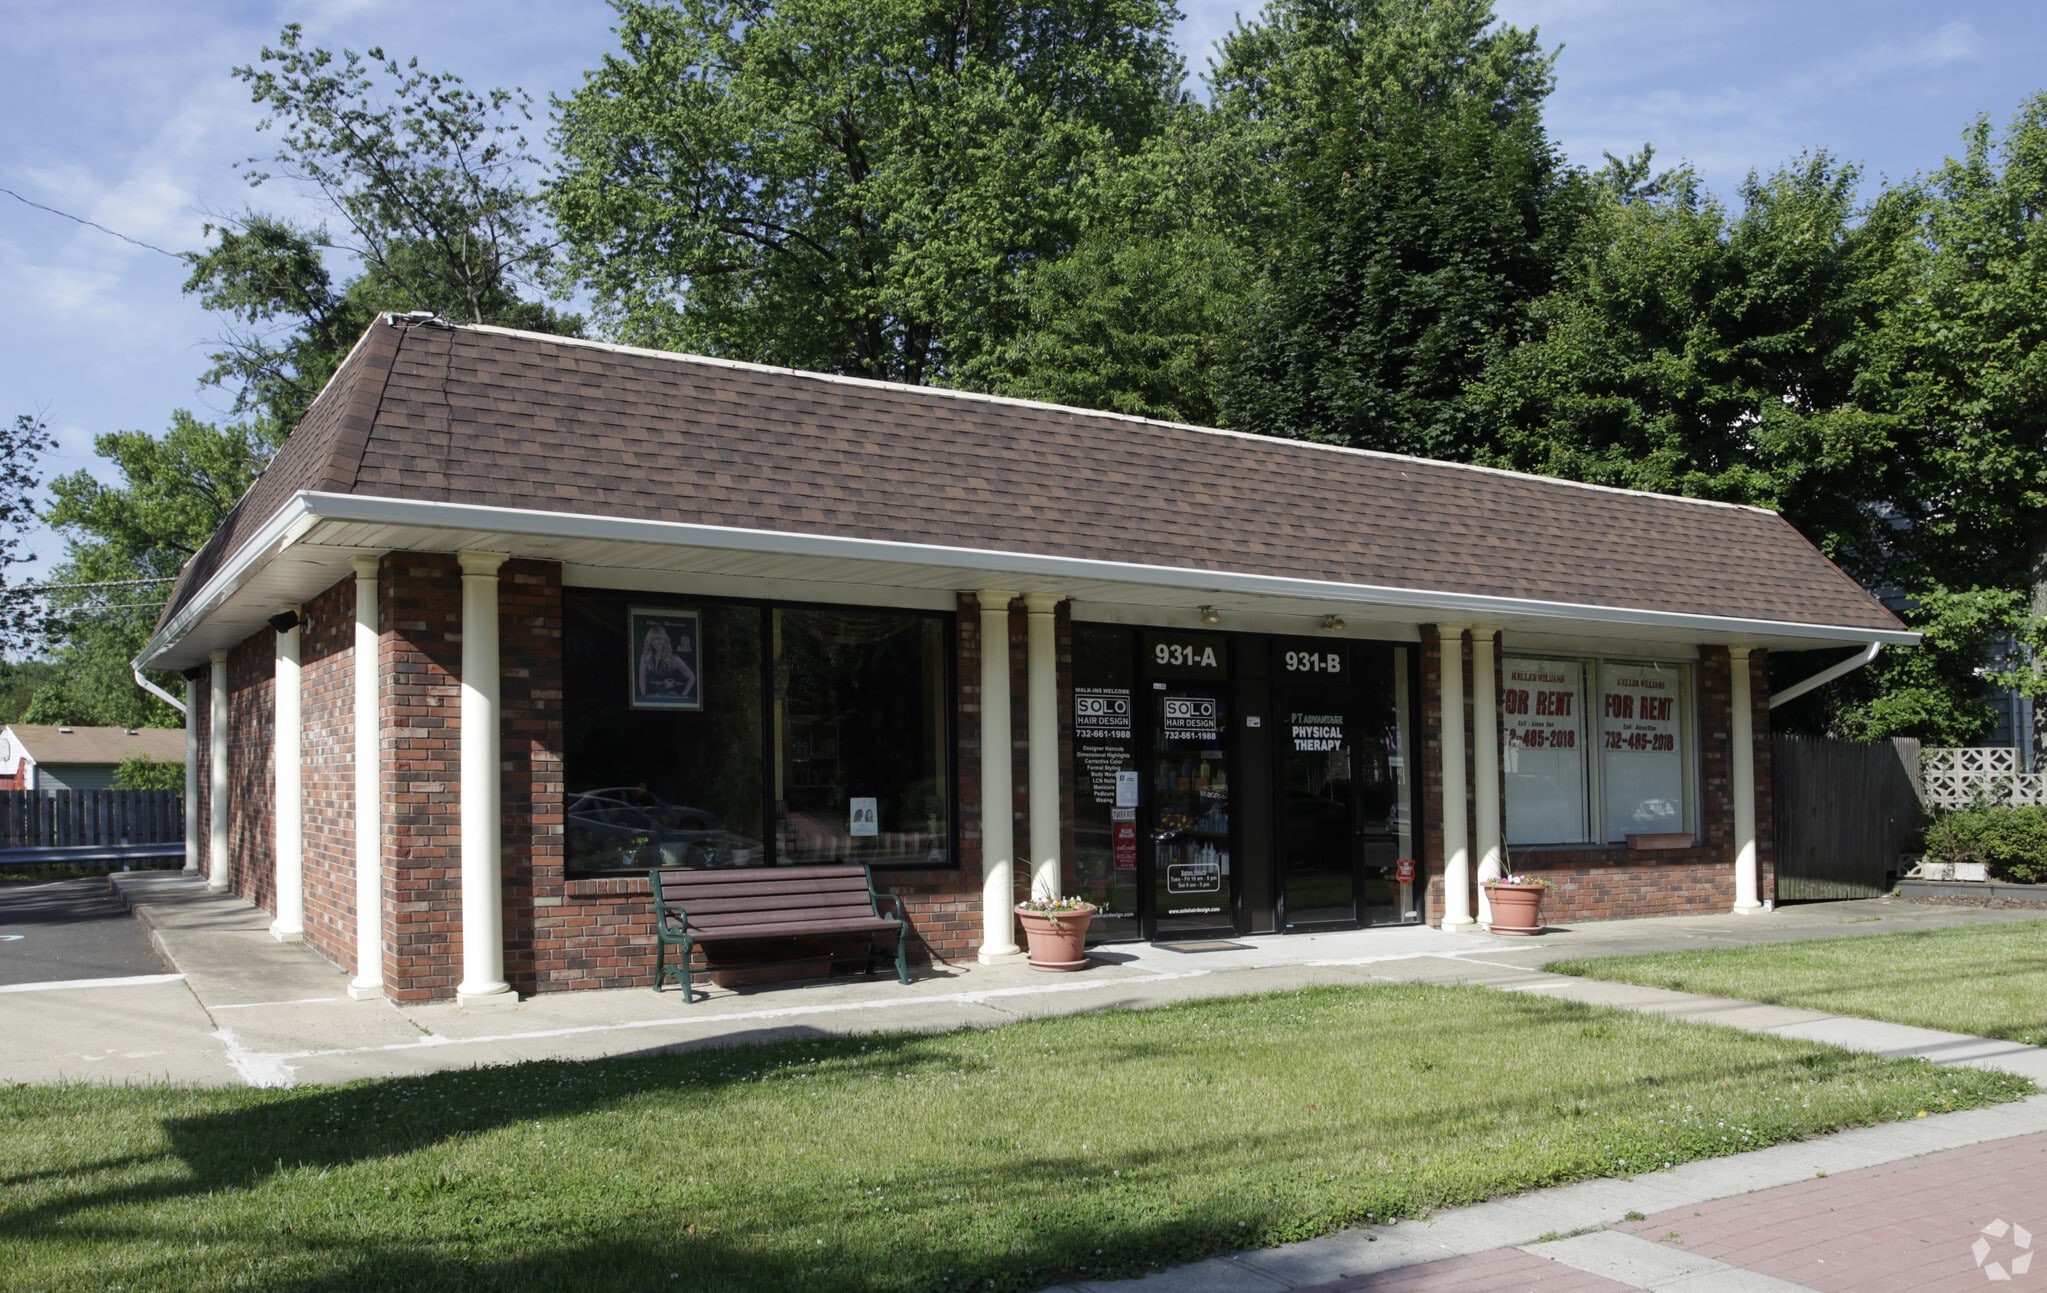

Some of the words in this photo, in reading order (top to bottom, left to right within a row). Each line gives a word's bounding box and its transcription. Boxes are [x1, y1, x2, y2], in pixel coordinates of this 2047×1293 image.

[1155, 643, 1217, 667] 931-A
[1285, 651, 1341, 673] 931-B
[1511, 672, 1537, 682] KELLER
[1538, 673, 1565, 684] WILLIAMS
[1616, 678, 1639, 688] KELLER
[1640, 680, 1665, 690] WILLIAMS
[1079, 700, 1126, 713] SOLO
[1167, 702, 1212, 716] SOLO
[1536, 690, 1574, 716] RENT
[1604, 693, 1634, 719] FOR
[1639, 696, 1674, 721] RENT
[1077, 717, 1097, 725] HAIR
[1098, 717, 1129, 725] DESIGN
[1166, 719, 1185, 727] HAIR
[1186, 719, 1214, 728] DESIGN
[1303, 715, 1343, 725] ADVANTAGE
[1075, 729, 1131, 739] 732-661-1988
[1164, 731, 1216, 740] 732-661-1988
[1292, 726, 1343, 738] PHYSICAL
[1294, 739, 1341, 751] THERAPY
[1604, 730, 1674, 751] 732-485-2018
